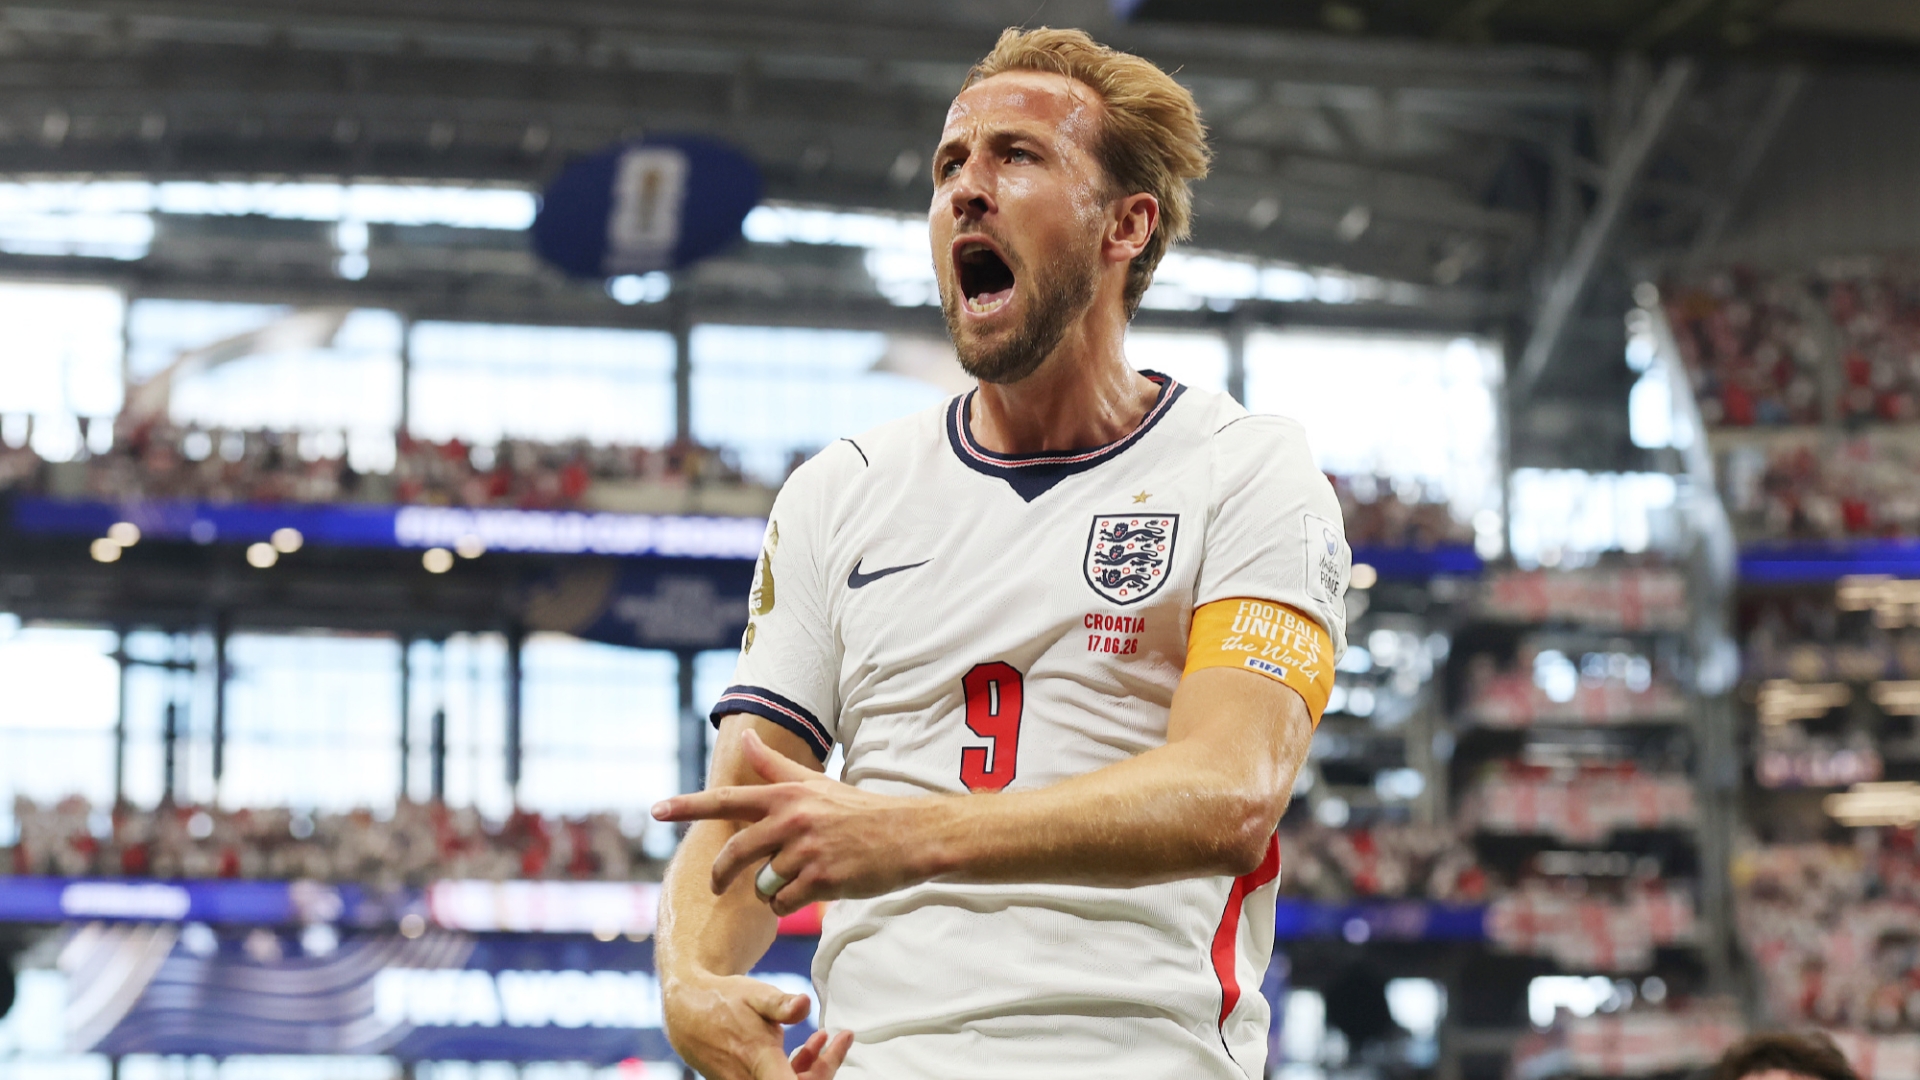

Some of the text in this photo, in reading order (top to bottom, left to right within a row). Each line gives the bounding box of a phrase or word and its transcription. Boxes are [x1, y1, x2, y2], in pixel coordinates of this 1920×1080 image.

[1084, 613, 1145, 634] CROATIA
[1087, 634, 1138, 655] 17.06.26
[1231, 615, 1320, 664] UNITES
[1238, 601, 1321, 648] FOOTBALL
[1221, 634, 1320, 684] the World
[1249, 658, 1283, 677] FIFA
[959, 661, 1025, 794] 9
